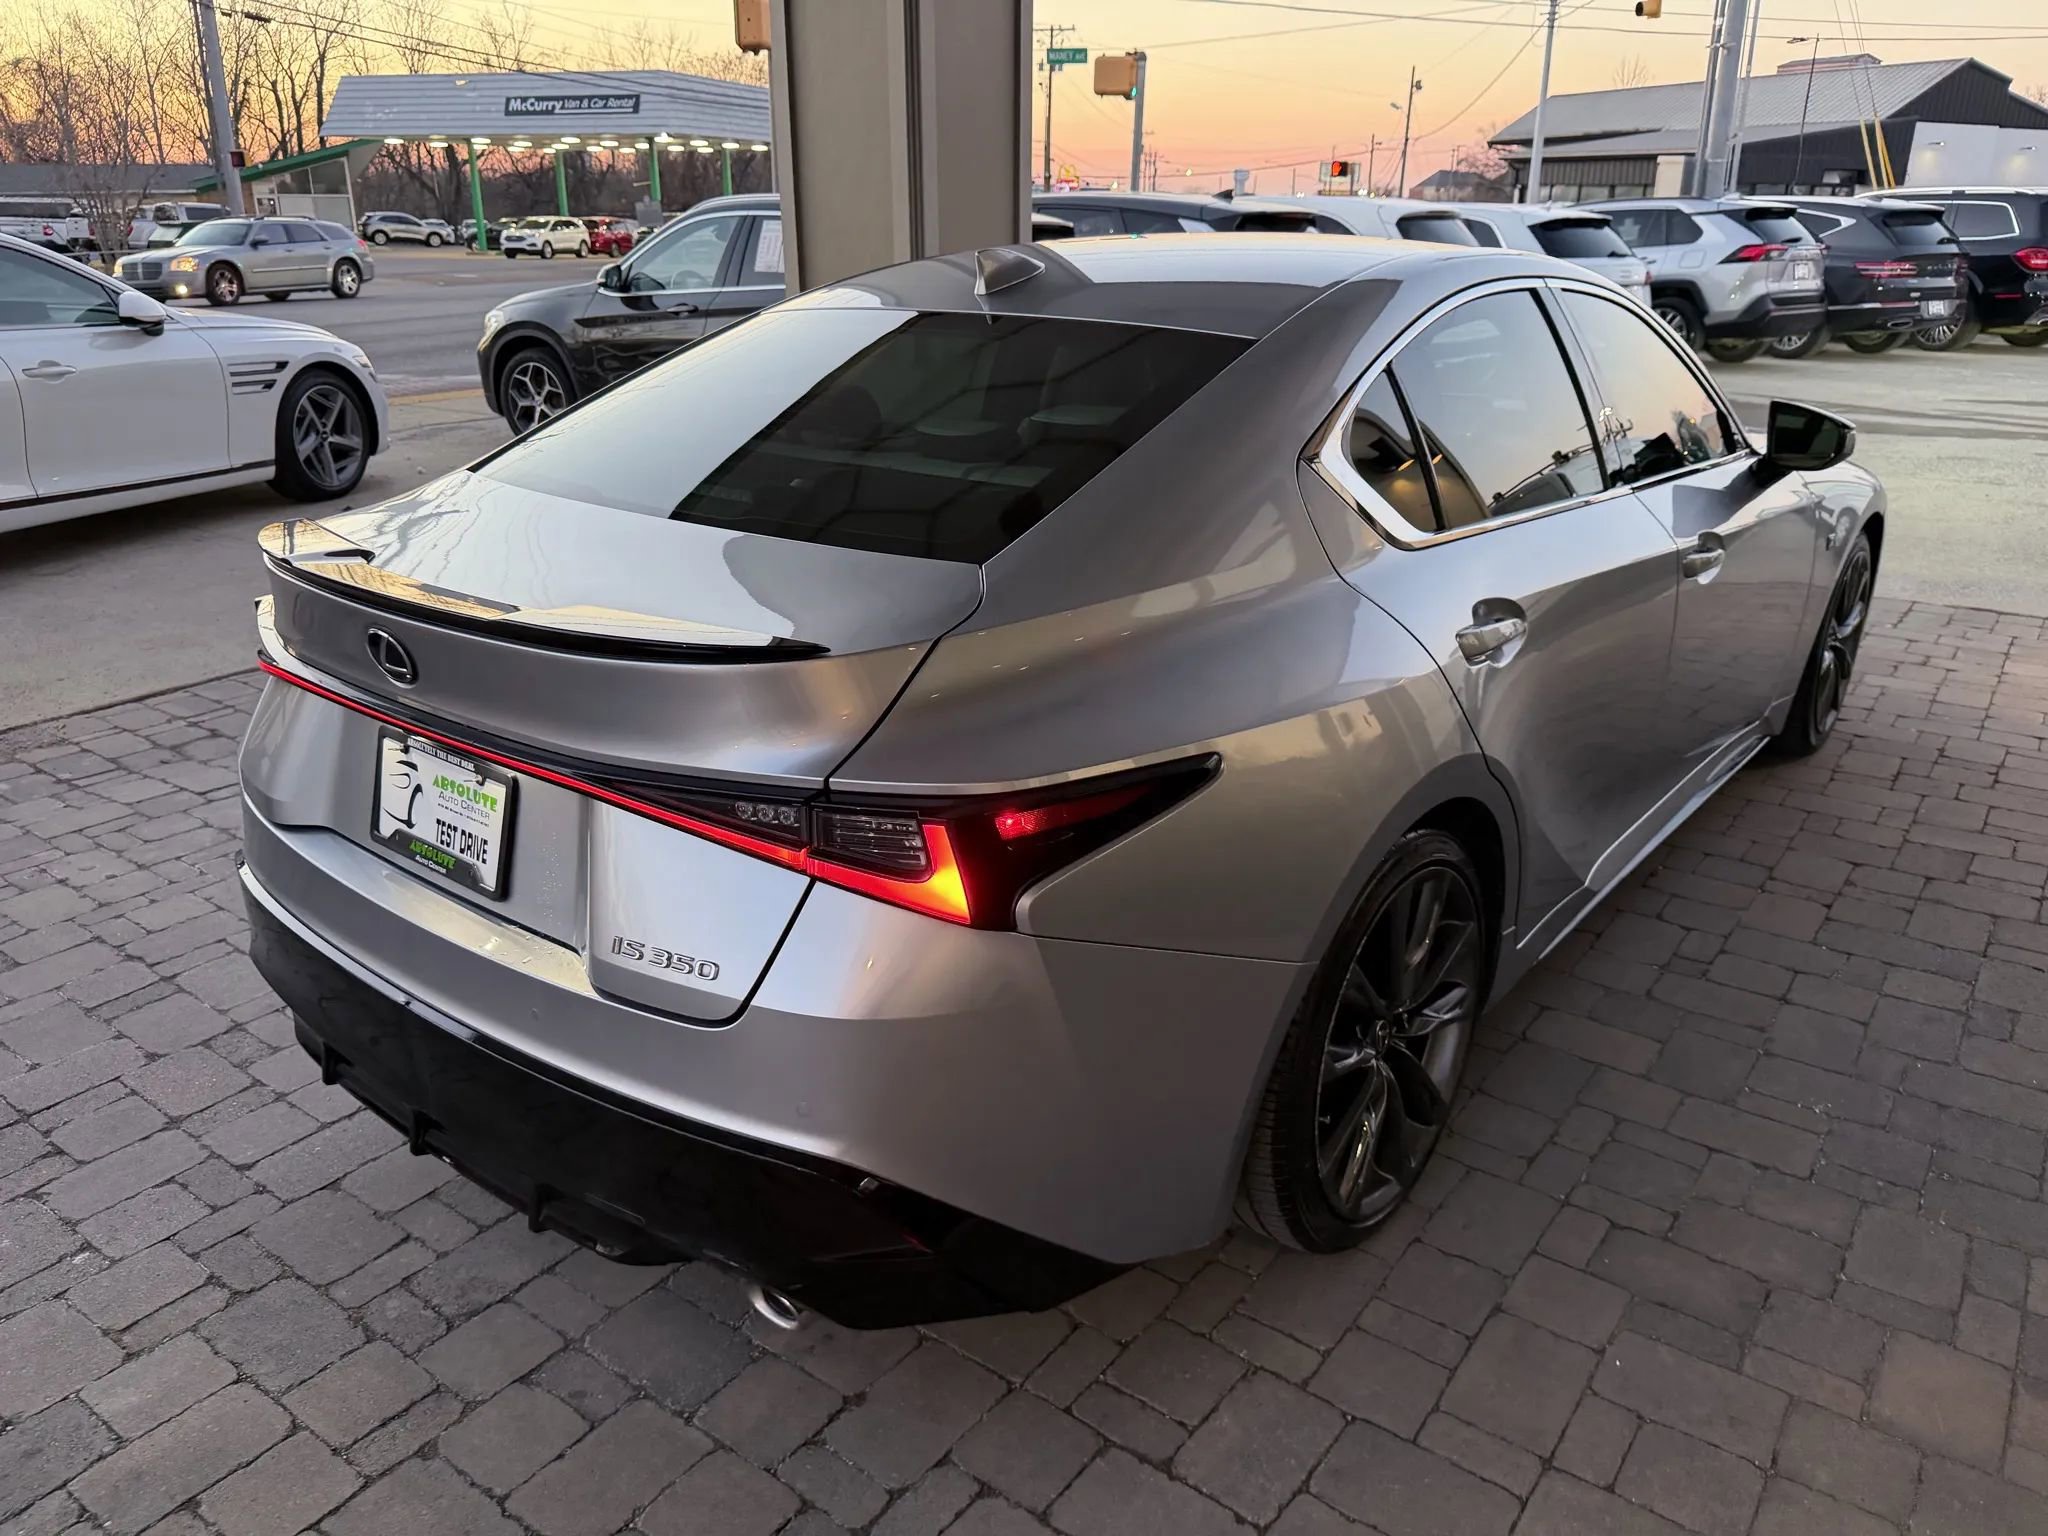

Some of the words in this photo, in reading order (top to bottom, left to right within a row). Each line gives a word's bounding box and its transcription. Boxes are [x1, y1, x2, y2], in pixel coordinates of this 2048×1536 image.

[508, 98, 562, 113] McCurry
[563, 99, 580, 108] Van
[590, 98, 607, 108] Car
[606, 97, 636, 107] Rental
[432, 774, 497, 813] ABSOLUTE
[438, 791, 459, 806] AUTO
[460, 798, 490, 820] CENTER
[409, 839, 457, 870] ABSOLUTE
[435, 818, 458, 850] TEST
[459, 829, 489, 865] DRIVE
[611, 935, 645, 961] IS
[648, 946, 720, 981] 350
